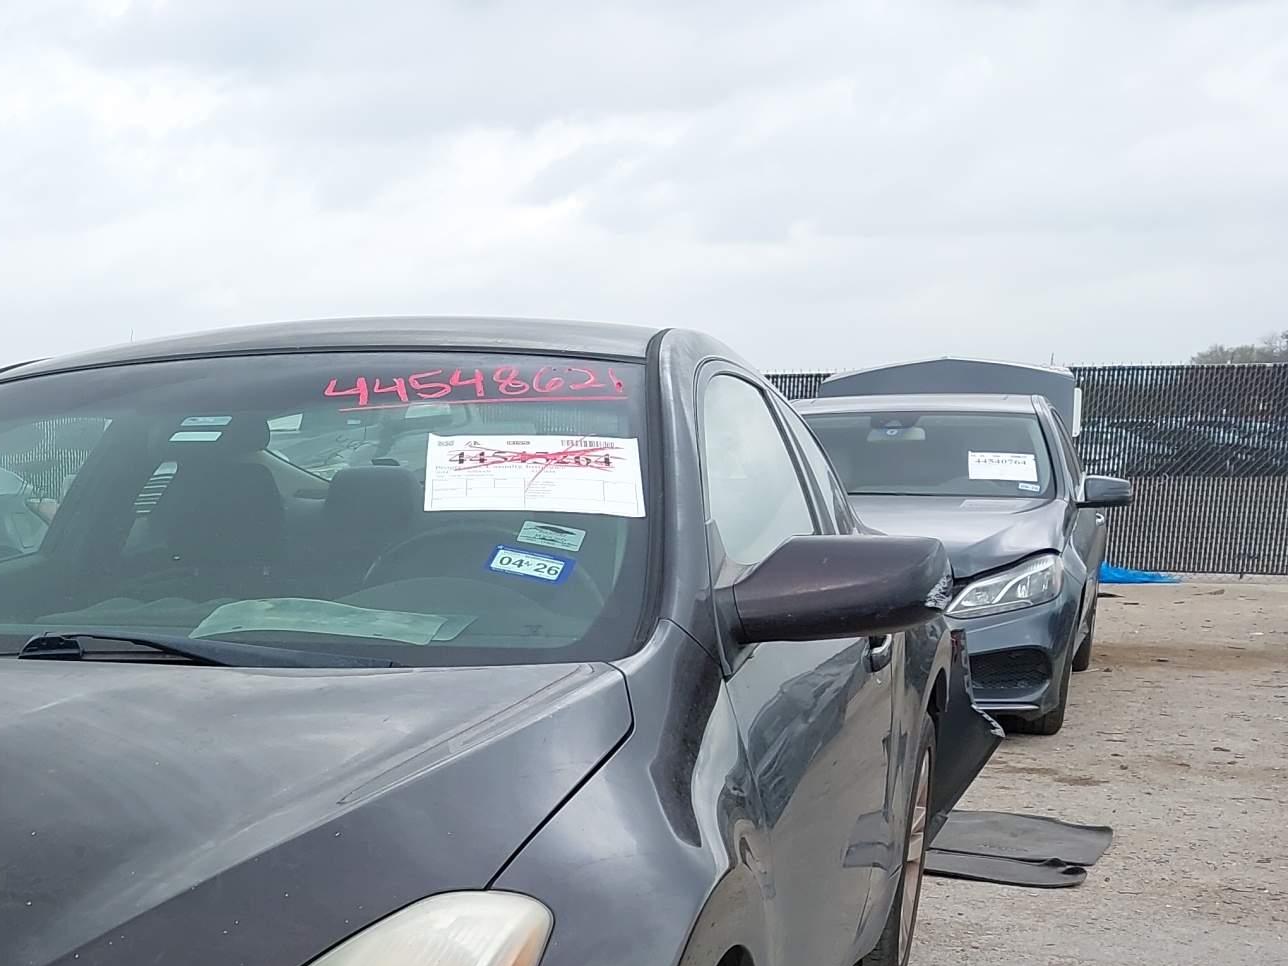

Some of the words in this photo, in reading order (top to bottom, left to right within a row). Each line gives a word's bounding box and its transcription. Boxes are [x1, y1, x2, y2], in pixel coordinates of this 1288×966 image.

[323, 366, 624, 406] 44548621
[499, 556, 524, 568] 04
[533, 562, 561, 576] 26
